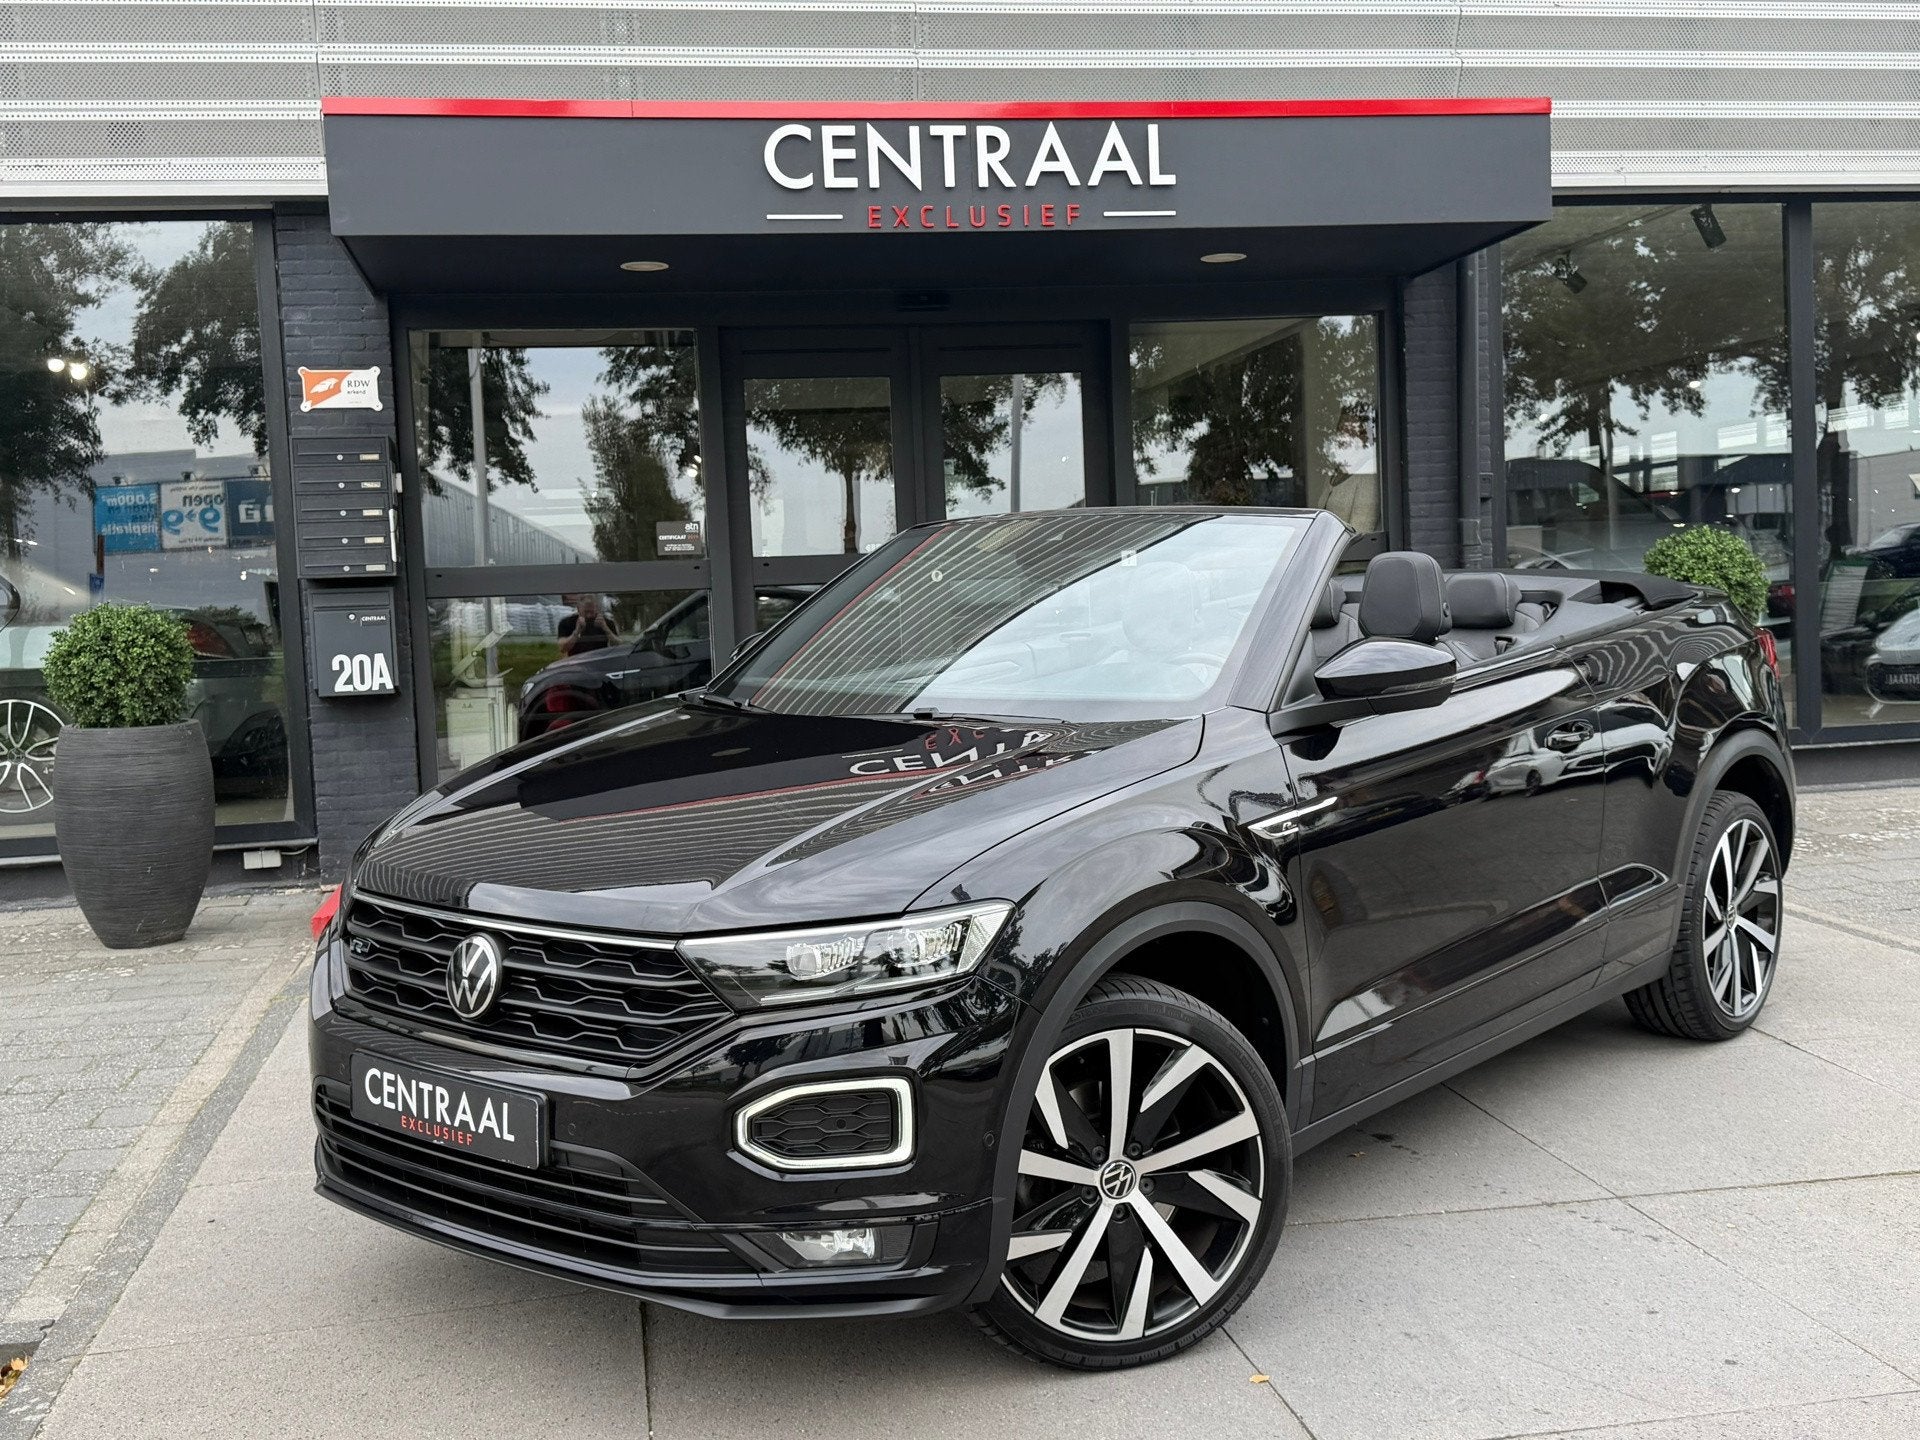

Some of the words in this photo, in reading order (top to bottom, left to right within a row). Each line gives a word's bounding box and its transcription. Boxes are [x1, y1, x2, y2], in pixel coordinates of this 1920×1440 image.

[763, 119, 1177, 191] CENTRAAL
[867, 202, 1081, 229] EXCLUSIEF
[346, 380, 371, 388] RDW
[331, 652, 394, 693] 20A
[364, 1067, 515, 1142] CENTRAAL
[401, 1115, 474, 1146] EXCLUSIEF
